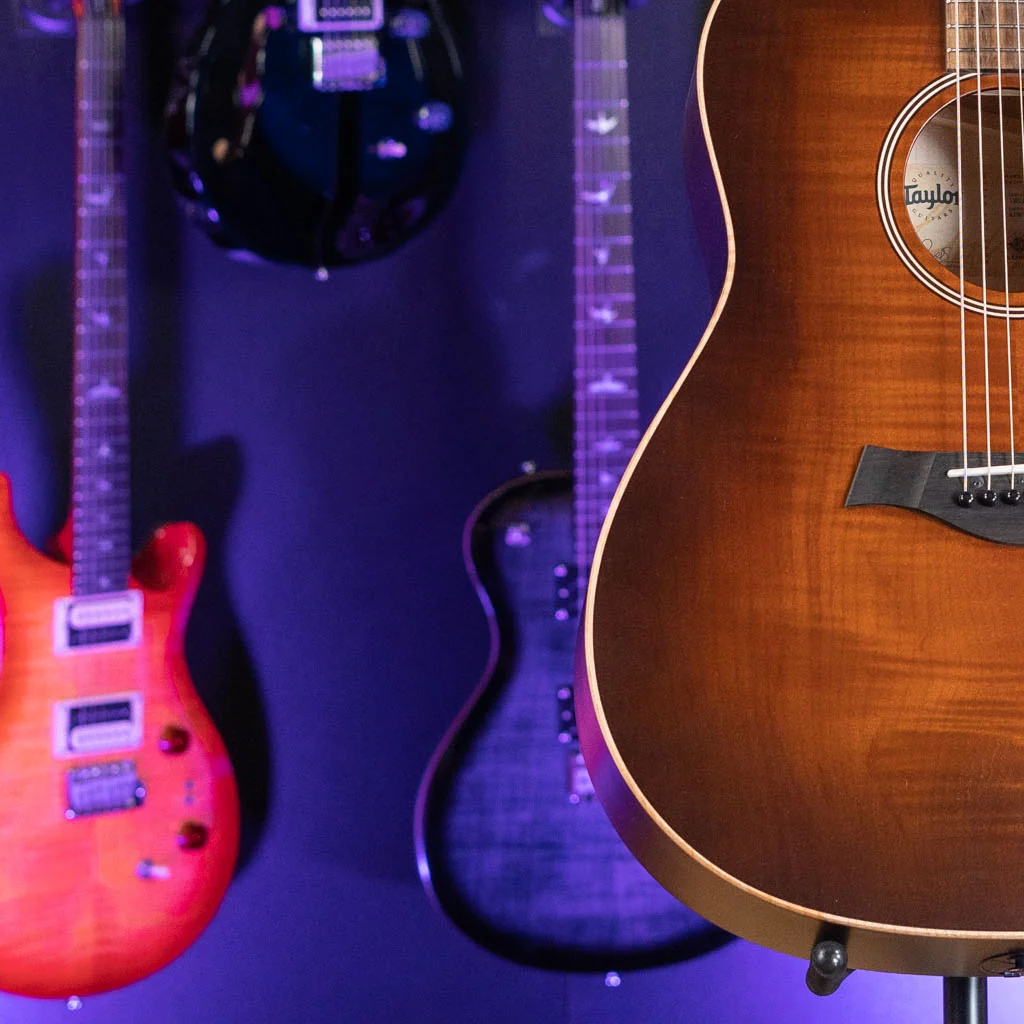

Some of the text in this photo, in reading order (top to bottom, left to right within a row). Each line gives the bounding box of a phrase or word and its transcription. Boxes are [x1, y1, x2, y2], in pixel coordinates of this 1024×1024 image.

[911, 170, 955, 188] QUALITY
[904, 183, 962, 210] Taylor
[911, 208, 953, 221] GUITARS
